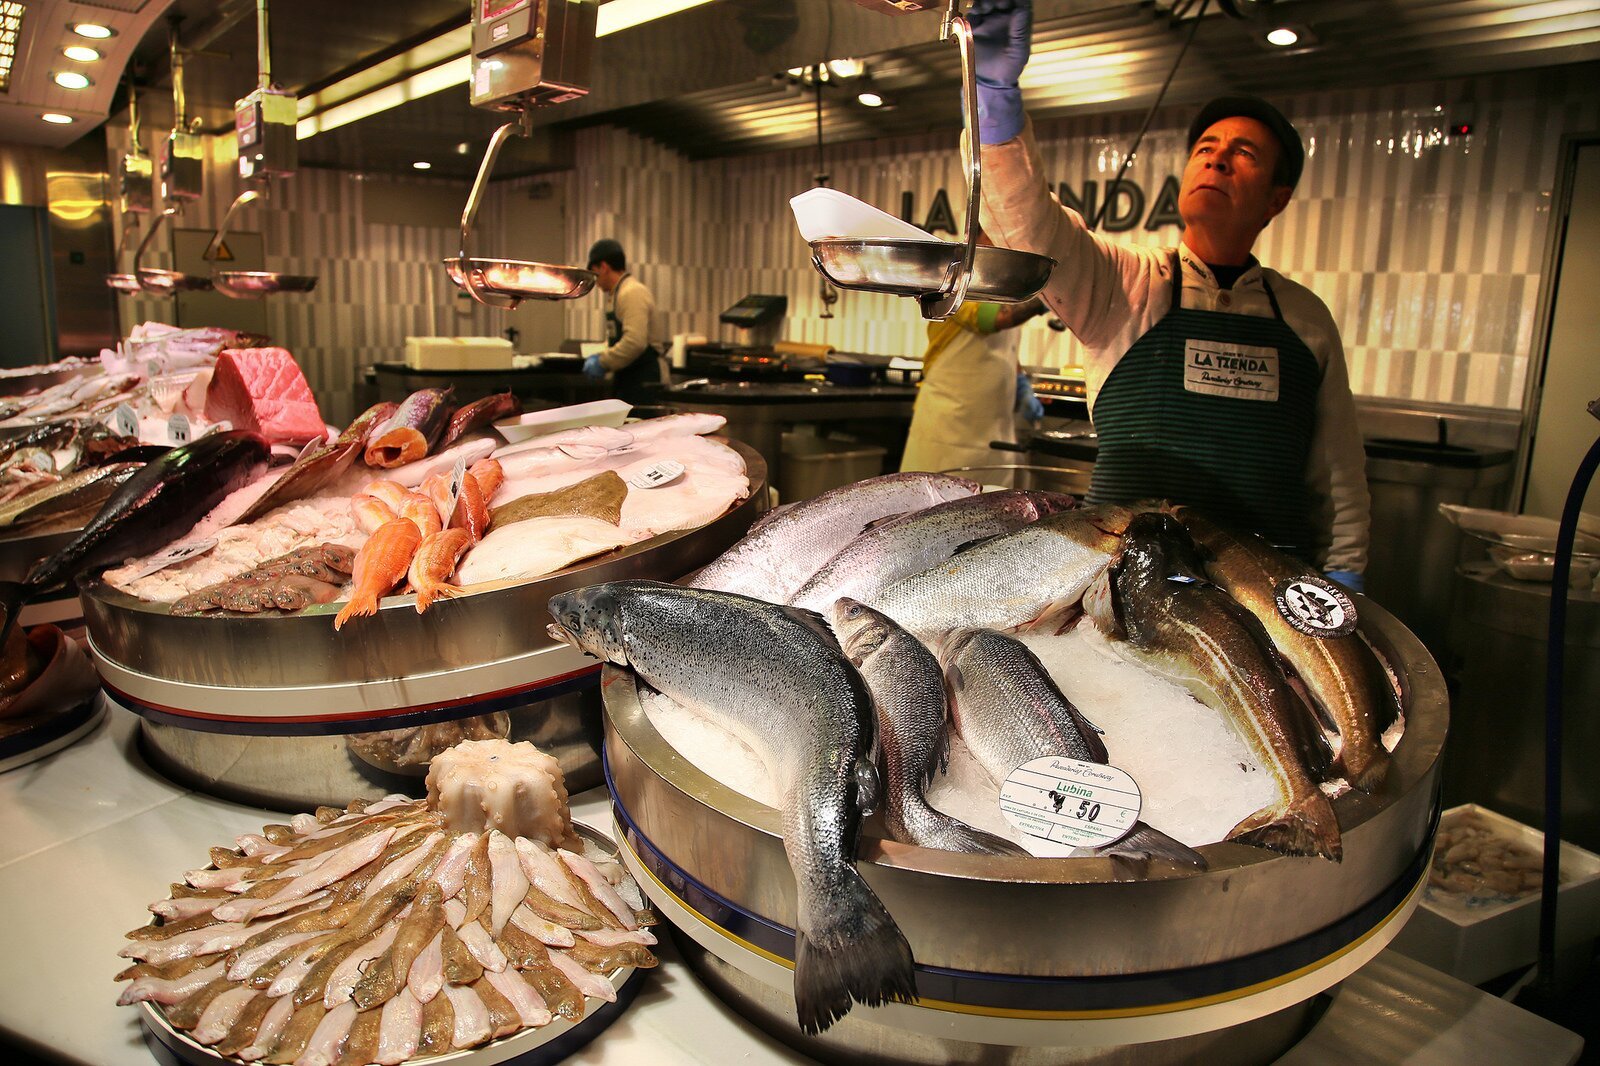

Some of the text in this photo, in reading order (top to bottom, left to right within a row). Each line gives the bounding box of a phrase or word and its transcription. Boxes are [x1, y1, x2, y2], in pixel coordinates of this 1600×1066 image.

[1049, 175, 1187, 232] NDA
[1194, 353, 1213, 367] LA
[1216, 356, 1268, 372] TIENDA
[1056, 781, 1093, 797] Lubina
